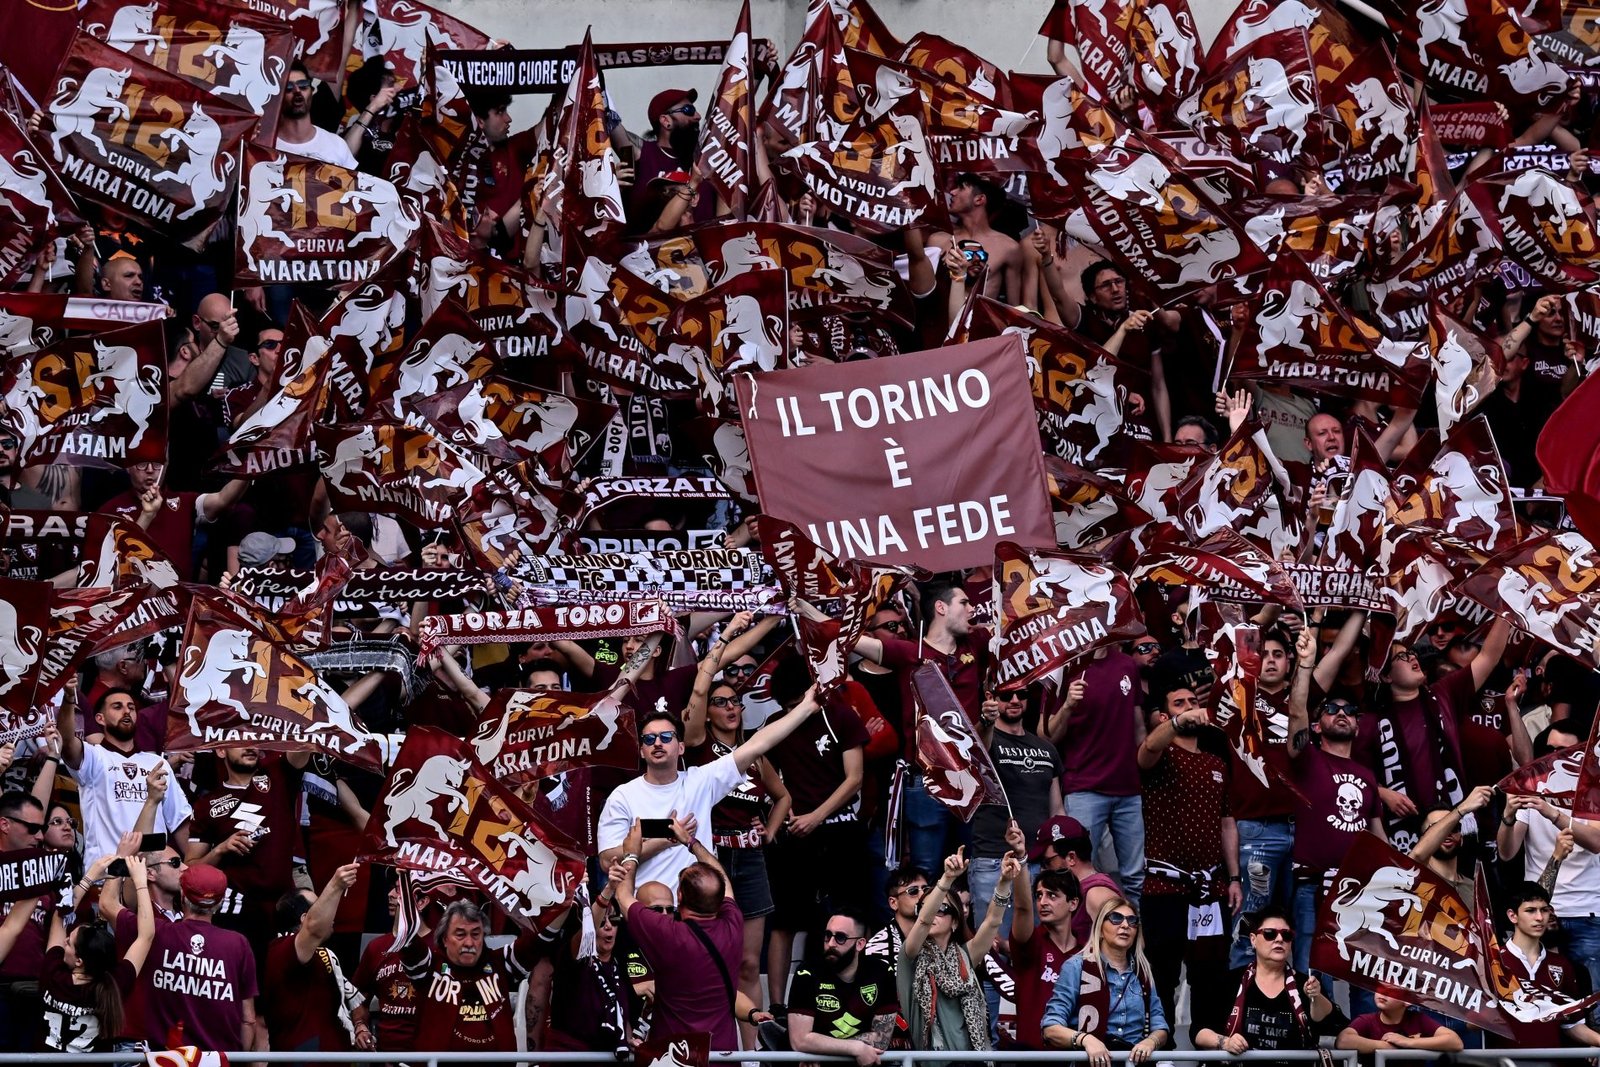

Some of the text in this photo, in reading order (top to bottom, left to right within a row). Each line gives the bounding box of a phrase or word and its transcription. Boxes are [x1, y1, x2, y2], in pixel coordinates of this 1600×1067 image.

[1541, 35, 1586, 67] CURVA
[467, 60, 558, 86] VECCHIO CUORE
[109, 83, 185, 168] 12
[712, 106, 741, 146] CURVA
[108, 151, 151, 182] CURVA
[61, 153, 177, 225] MARATONA
[287, 164, 358, 232] 12
[297, 238, 345, 253] CURVA
[258, 258, 382, 282] MARATONA
[1267, 358, 1391, 393] MARATONA
[775, 368, 992, 437] IL TORINO
[882, 437, 913, 488] È
[595, 477, 693, 500] FORZA
[808, 494, 1016, 560] UNA FEDE
[658, 549, 744, 570] TORINO
[577, 570, 608, 592] FC
[695, 570, 723, 592] FC
[450, 603, 626, 633] FORZA TORO
[1348, 597, 1393, 611] FEDE
[1009, 613, 1059, 646] CURVA
[250, 641, 318, 721] 12
[251, 713, 302, 736] CURVA
[507, 724, 555, 746] CURVA
[727, 791, 759, 803] SUZUKI
[1332, 773, 1368, 790] ULTRAS
[448, 775, 525, 872] 12
[1325, 814, 1368, 833] GRANATA
[1400, 880, 1471, 958] 12
[162, 948, 227, 980] LATINA
[1399, 944, 1451, 970] CURVA
[152, 969, 235, 1002] GRANATA
[1350, 949, 1484, 1014] MARATONA
[43, 1010, 100, 1054] 12
[1247, 1023, 1289, 1039] ME TAKE
